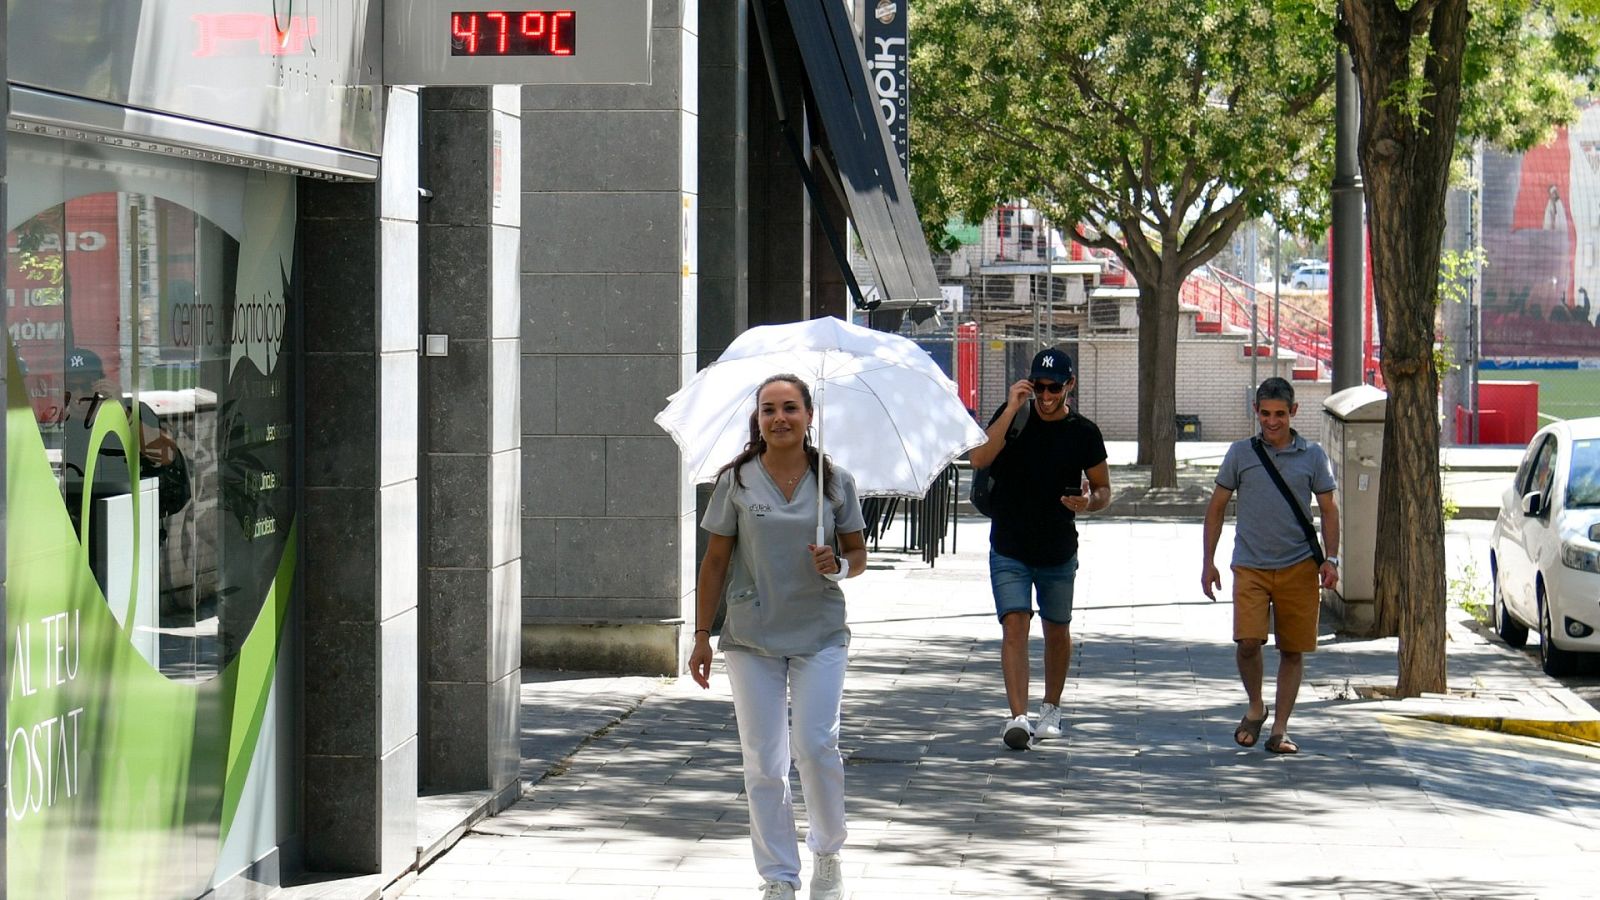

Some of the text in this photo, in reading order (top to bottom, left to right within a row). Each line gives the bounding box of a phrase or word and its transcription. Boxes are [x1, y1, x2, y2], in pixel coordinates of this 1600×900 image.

[1041, 355, 1054, 368] NY
[11, 608, 79, 701] AL TEU
[6, 708, 83, 821] OSTAT
